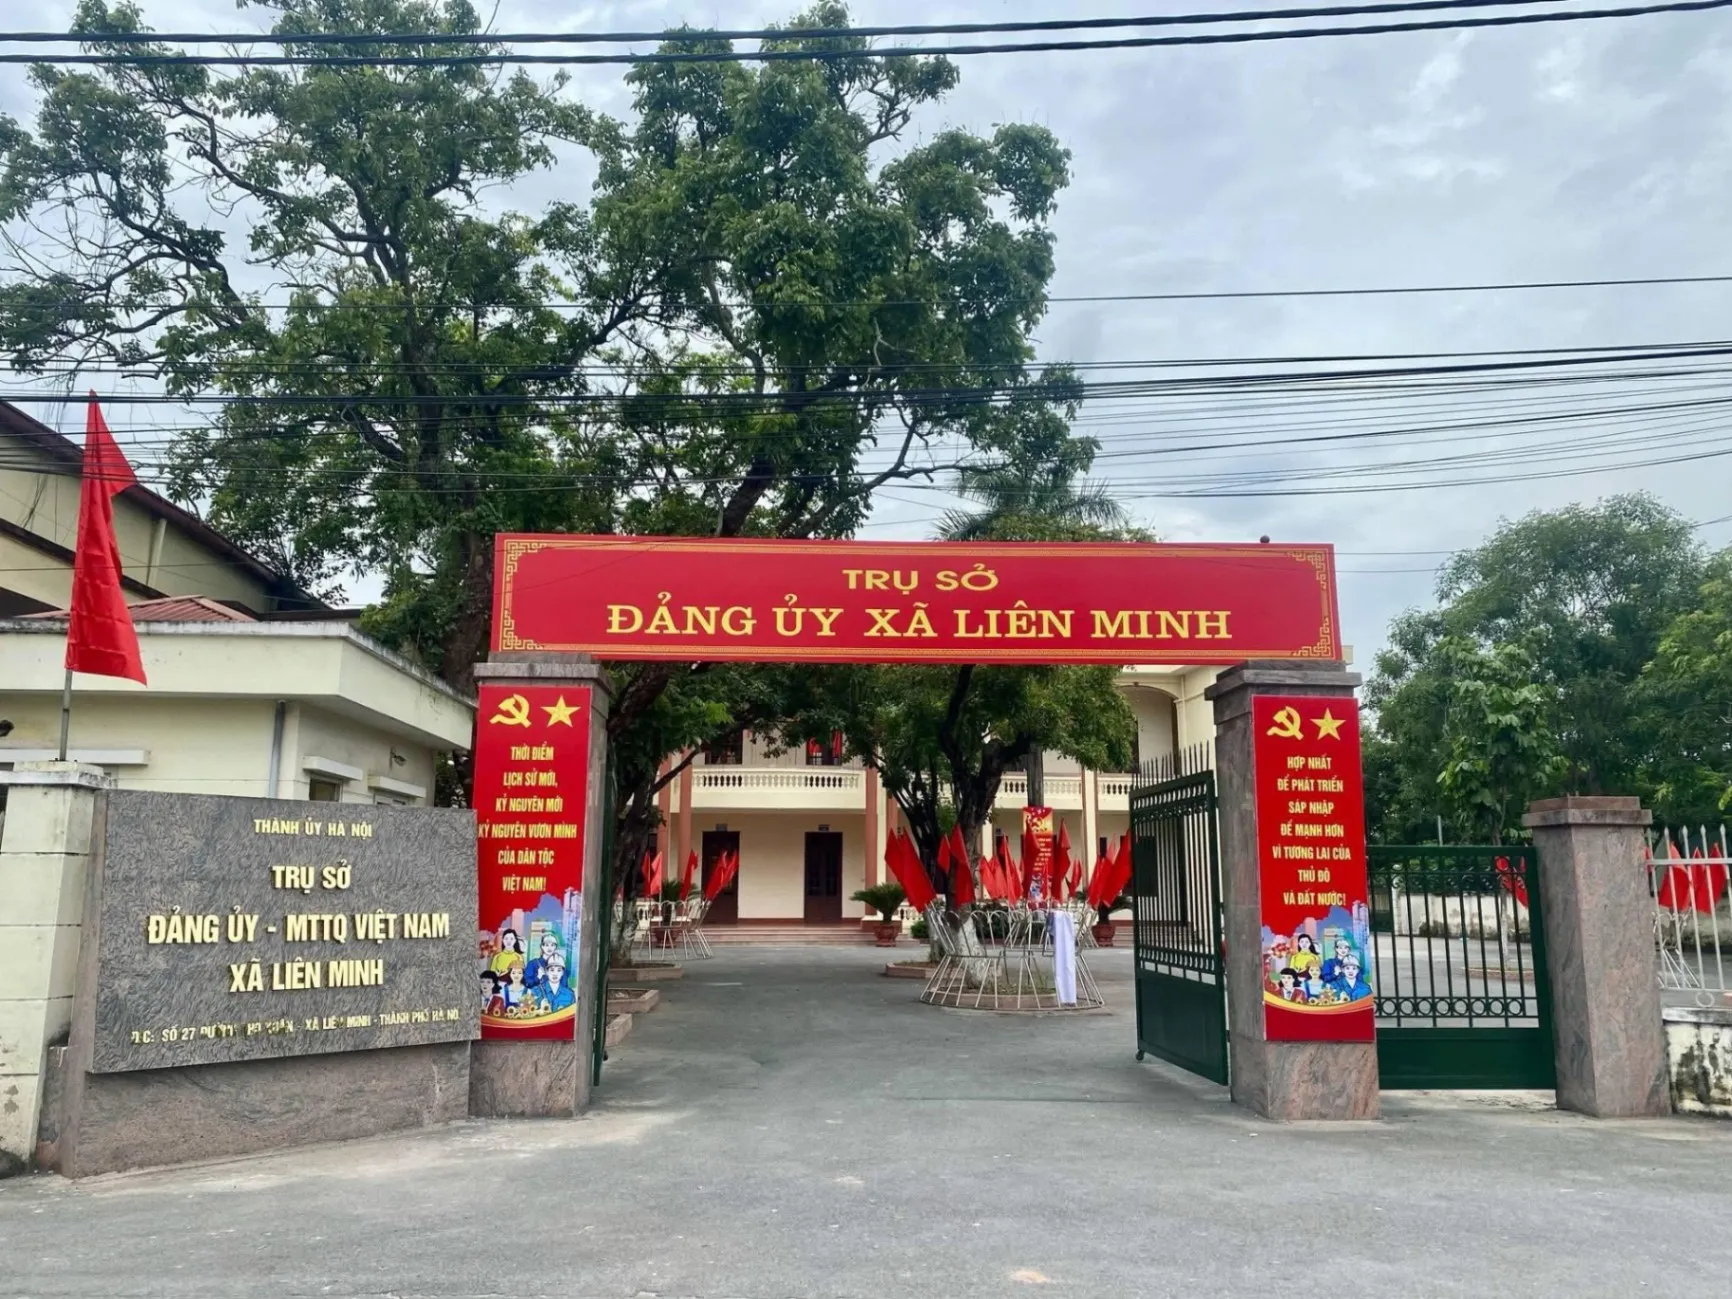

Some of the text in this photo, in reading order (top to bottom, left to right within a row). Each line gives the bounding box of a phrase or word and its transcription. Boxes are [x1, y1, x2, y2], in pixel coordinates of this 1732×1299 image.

[842, 563, 999, 594] TRỤ SỞ
[606, 591, 1233, 639] ĐẢNG ỦY XÃ LIÊN MINH
[511, 743, 530, 761] THỜI
[1287, 753, 1332, 772] HỢP NHẤT
[503, 771, 523, 789] LỊCH
[525, 767, 538, 786] SỬ
[1277, 774, 1344, 792] ĐỂ PHÁT TRIỂN
[496, 793, 563, 812] KỶ NGUYÊN MỚI
[1288, 798, 1335, 817] SÁP NHẬP
[253, 816, 373, 839] THÀNH ỦY HÀ NỘI
[478, 819, 577, 838] KỶ NGUYÊN VƯƠN MÌNH
[1280, 819, 1344, 839] ĐỂ MẠNH HƠN
[498, 845, 555, 868] CỦA DÂN TỘC
[1272, 843, 1351, 860] VÌ TƯƠNG LAI CỦA
[272, 859, 352, 894] TRỤ SỞ
[1298, 865, 1331, 882] THỦ ĐÔ
[502, 874, 546, 894] VIỆT NAM!
[1283, 888, 1346, 906] VÀ ĐẤT NƯỚC!
[148, 905, 220, 944] ĐẢNG
[227, 905, 259, 943] ỦY
[286, 913, 347, 943] MTTQ
[355, 908, 398, 944] VIỆT
[403, 913, 450, 939] NAM
[229, 956, 384, 993] XÃ LIÊN MINH
[181, 1027, 196, 1041] 27
[347, 1014, 371, 1028] MINH
[379, 1011, 410, 1026] THÀNH
